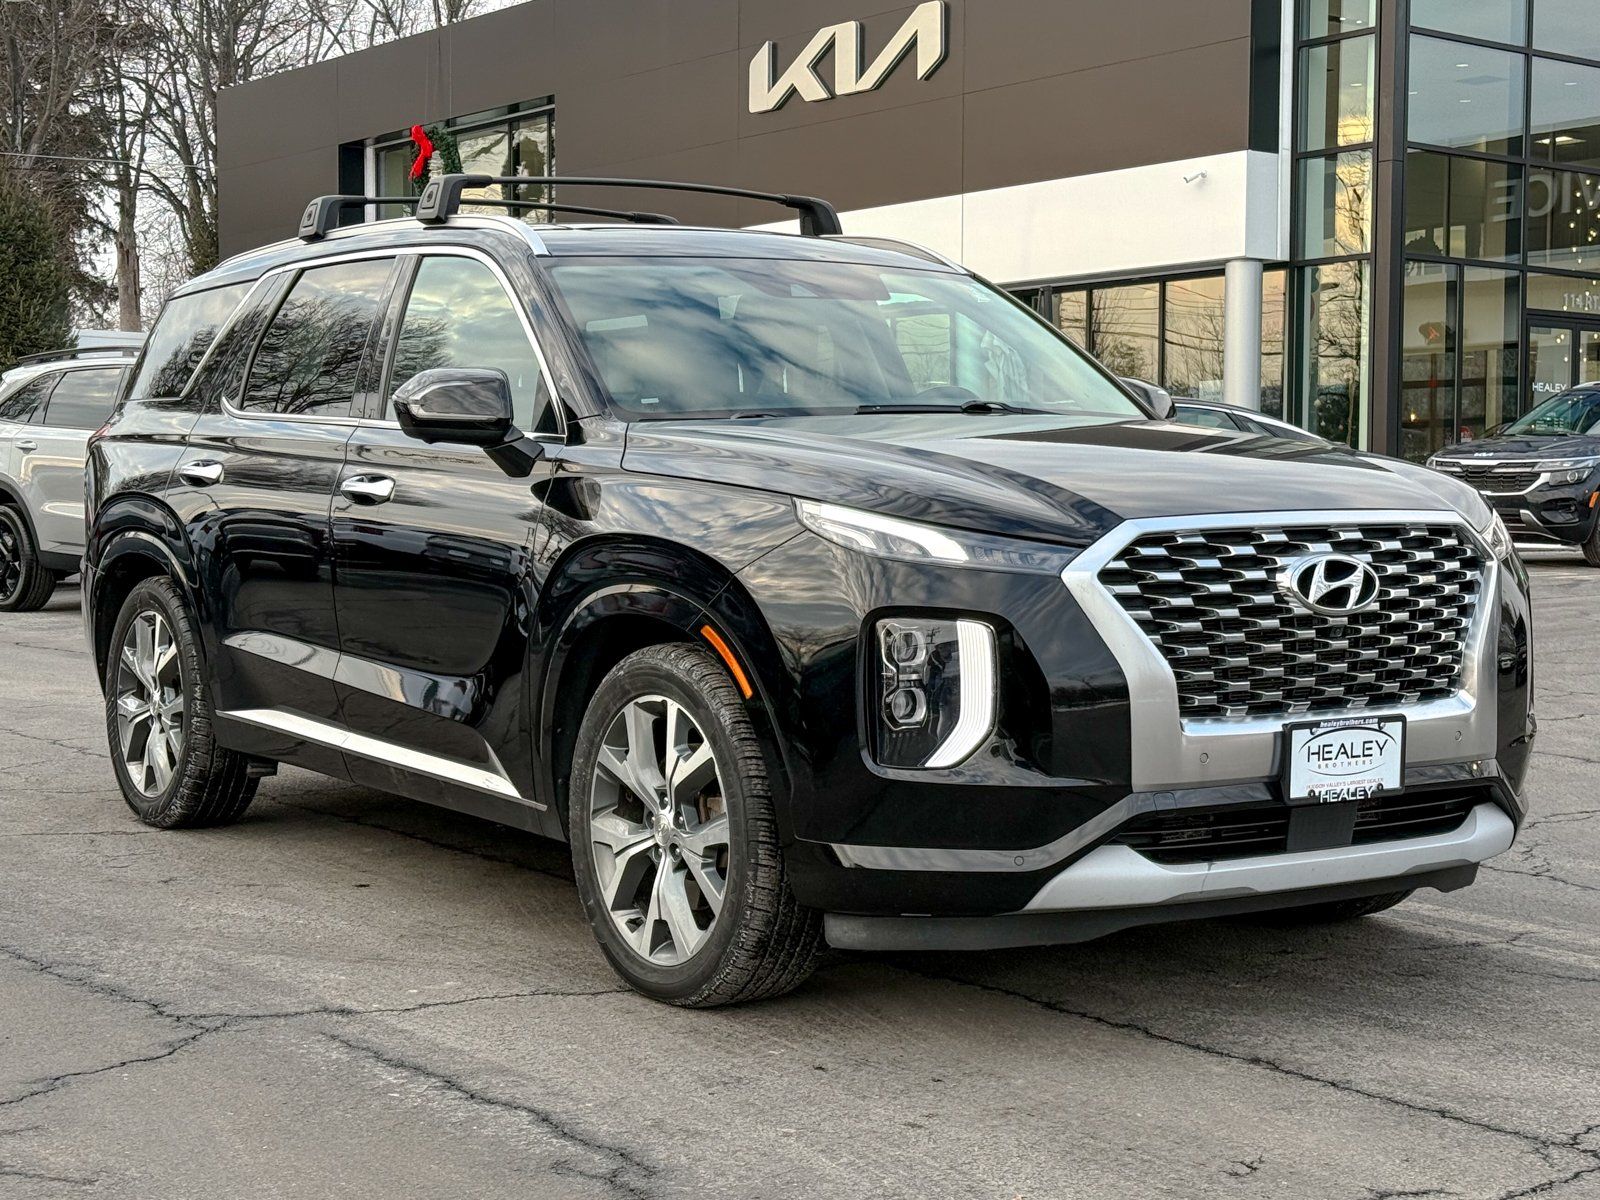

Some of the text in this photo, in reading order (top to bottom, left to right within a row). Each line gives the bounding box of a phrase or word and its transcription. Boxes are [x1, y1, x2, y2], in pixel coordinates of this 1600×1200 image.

[1532, 382, 1567, 392] HEALEY
[1320, 718, 1378, 728] healeybrothers.com
[1307, 739, 1389, 763] HEALEY
[1317, 759, 1373, 769] BROTHERS
[1320, 785, 1374, 803] HEALEY
